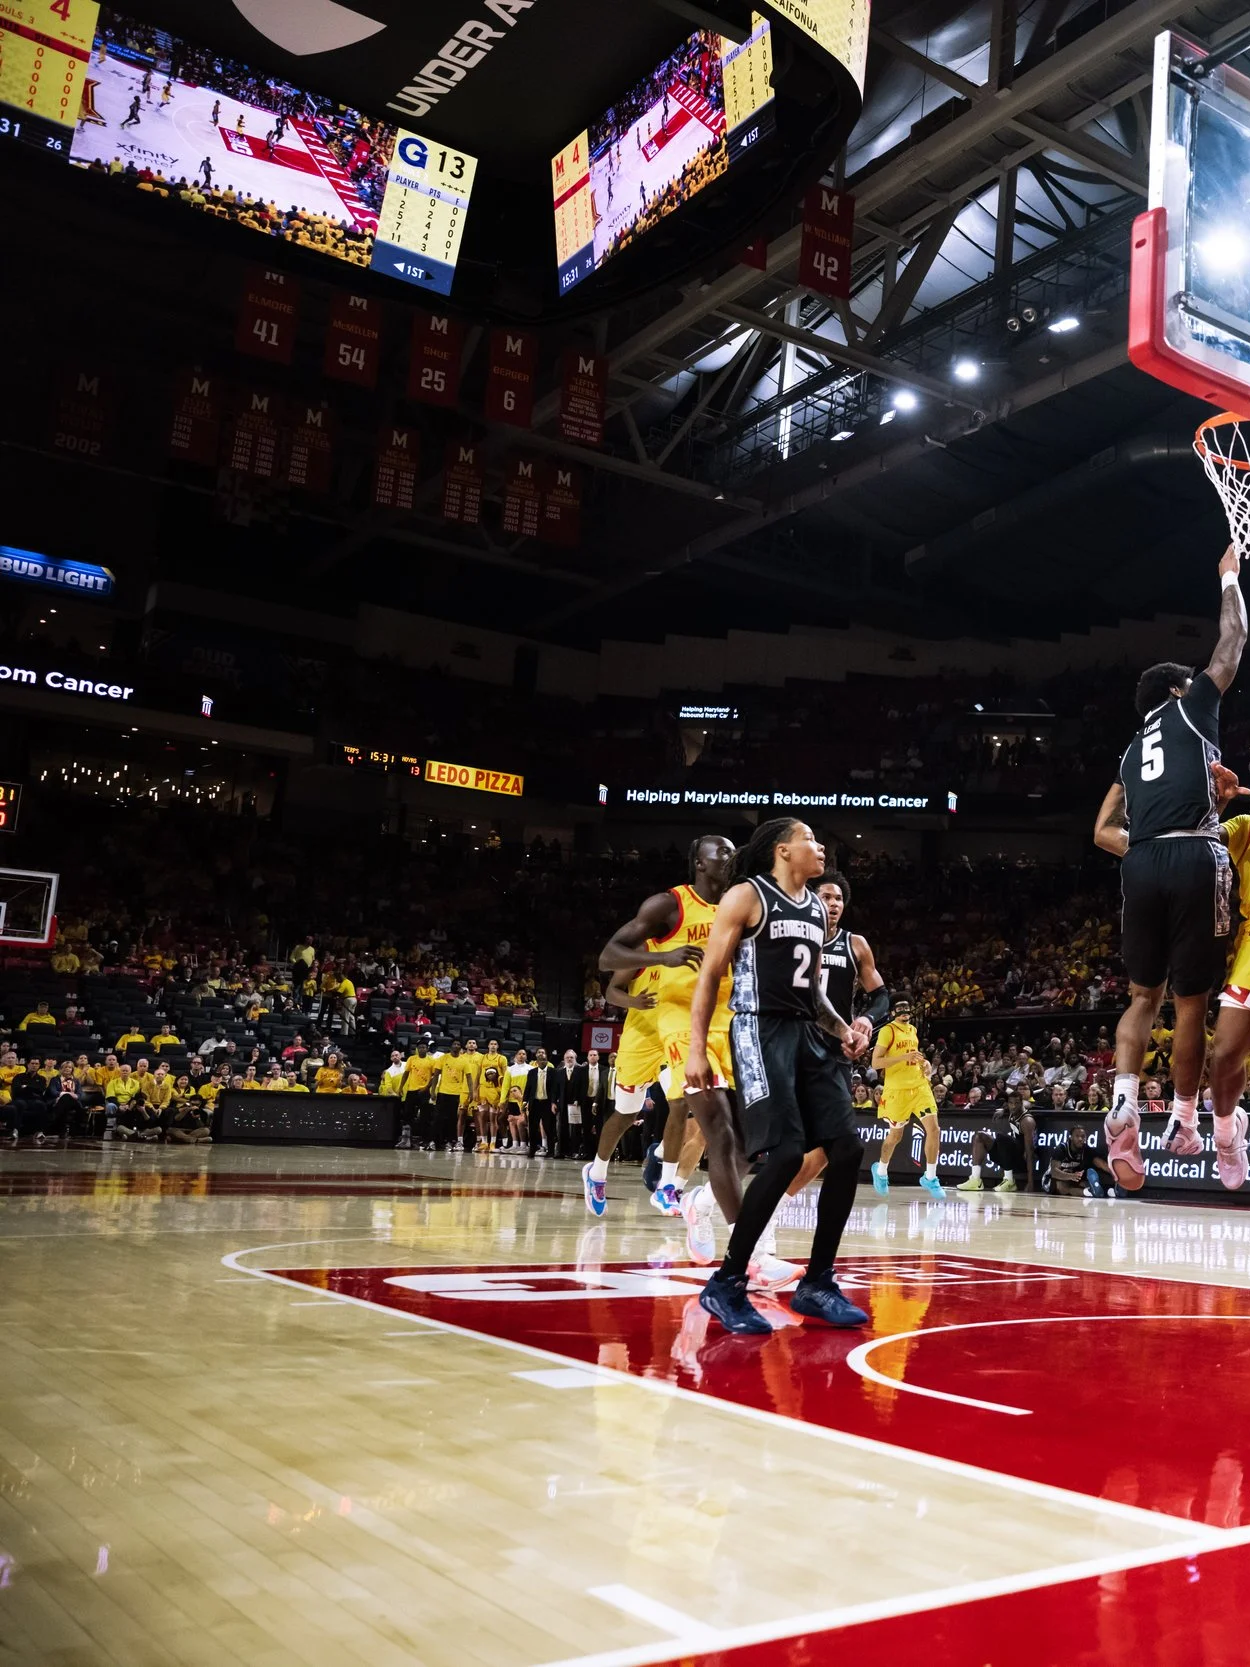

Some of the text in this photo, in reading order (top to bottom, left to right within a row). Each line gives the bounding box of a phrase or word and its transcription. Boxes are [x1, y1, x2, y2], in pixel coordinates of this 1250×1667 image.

[386, 20, 507, 117] UNDER
[46, 137, 62, 150] 26
[748, 126, 759, 144] 1ST
[398, 137, 429, 170] G
[438, 151, 466, 180] 13
[555, 143, 580, 177] M 4
[395, 175, 420, 190] PLAYER
[429, 188, 441, 199] PTS
[400, 200, 456, 228] 2 2 0
[430, 199, 436, 207] 0
[452, 207, 458, 216] 0
[821, 190, 840, 216] M
[395, 222, 452, 249] 7 4 0
[397, 211, 454, 238] 5 4 0
[391, 232, 401, 243] 11
[420, 243, 427, 252] 3
[407, 265, 425, 279] 1ST
[562, 257, 592, 288] 15:31 26
[812, 251, 839, 281] 42
[252, 318, 279, 347] 41
[429, 315, 449, 335] M
[504, 335, 524, 356] M
[337, 343, 366, 371] 54
[578, 356, 595, 377] M
[191, 377, 211, 397] M
[420, 368, 447, 393] 25
[250, 393, 270, 413] M
[503, 390, 516, 411] 6
[306, 407, 323, 428] M
[392, 430, 408, 449] M
[458, 446, 475, 465] M
[517, 461, 533, 479] M
[557, 470, 573, 488] M
[0, 557, 107, 591] BUD LIGHT
[45, 671, 134, 700] Cancer
[370, 751, 394, 764] 15:31
[1141, 730, 1164, 782] 5
[411, 766, 420, 776] 13
[426, 762, 522, 794] LEDO PIZZA
[626, 789, 928, 808] Helping Marylanders Rebound from Cancer
[770, 920, 824, 948] GEORGETOWN
[793, 944, 811, 988] 2
[821, 954, 847, 968] ETOWN
[669, 1042, 682, 1065] M
